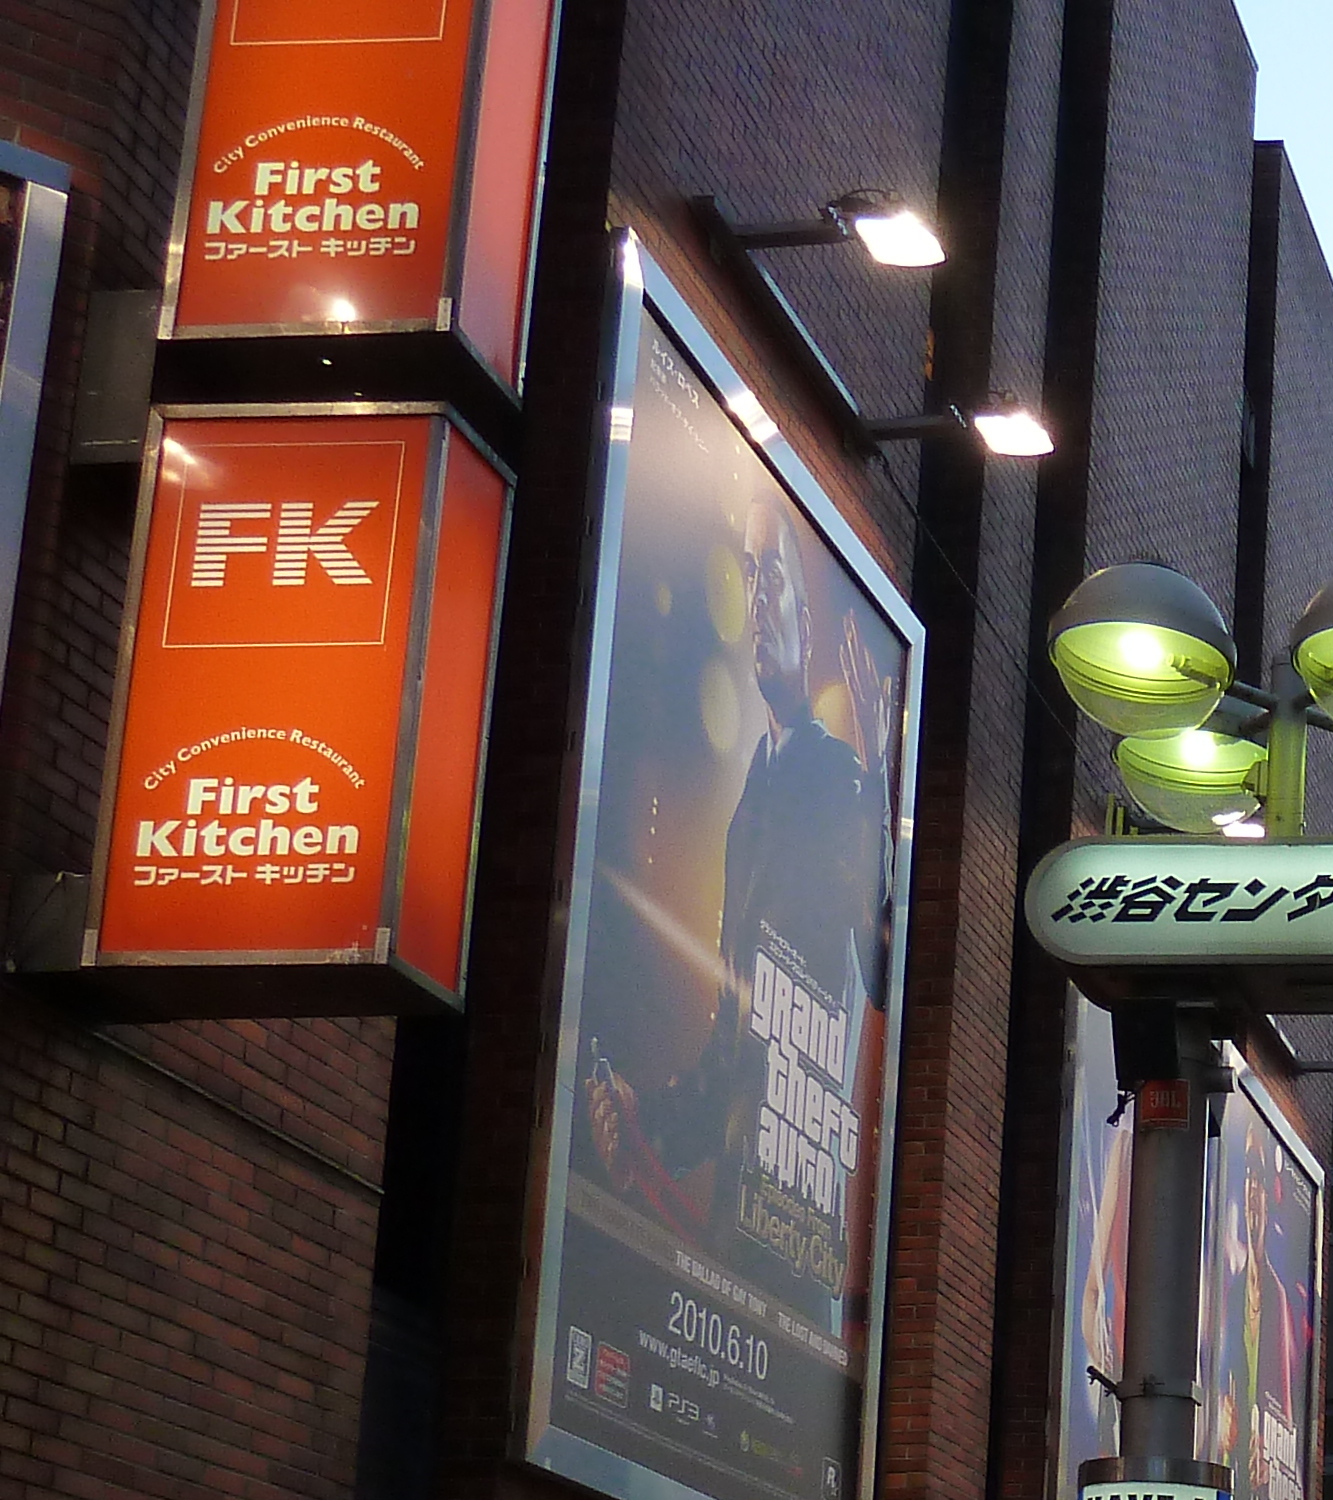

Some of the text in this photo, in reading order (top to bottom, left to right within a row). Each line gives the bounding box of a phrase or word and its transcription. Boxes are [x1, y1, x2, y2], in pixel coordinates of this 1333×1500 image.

[213, 114, 425, 174] City Convenience Restaurant
[254, 159, 381, 196] First
[205, 199, 419, 234] Kitchen
[204, 237, 417, 261] ファースト キッチン
[191, 501, 379, 587] FK
[143, 727, 365, 791] City Convenience Restaurant
[186, 777, 319, 815] First
[135, 820, 359, 857] Kitchen
[134, 863, 355, 885] ファースト キッチン
[668, 1292, 768, 1380] 2010.6.10
